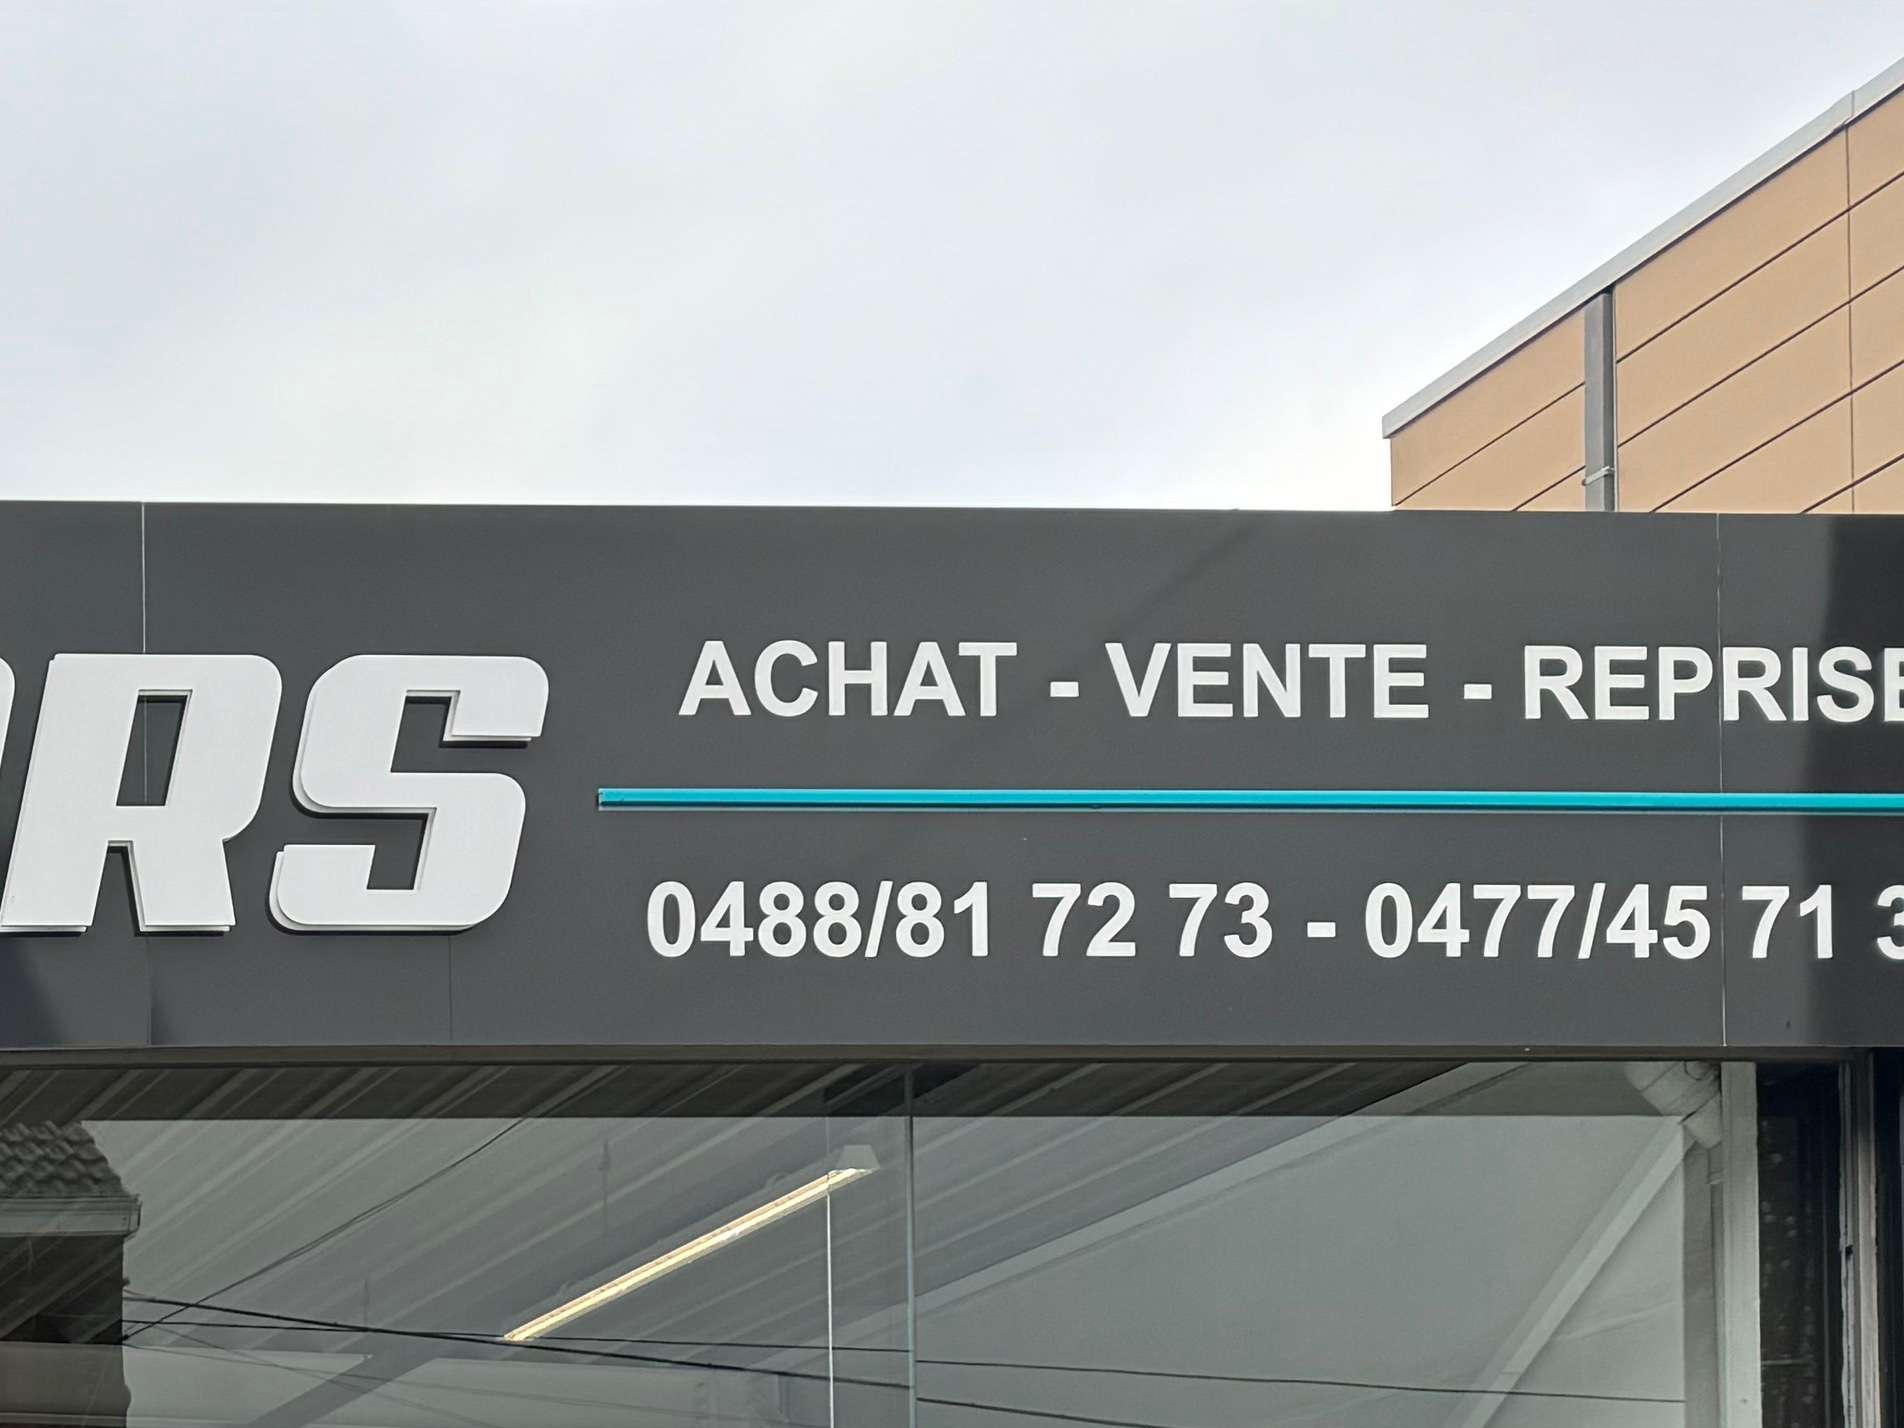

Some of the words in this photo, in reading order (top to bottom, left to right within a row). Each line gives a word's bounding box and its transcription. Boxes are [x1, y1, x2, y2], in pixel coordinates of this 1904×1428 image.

[677, 639, 1018, 718] ACHAT
[1049, 680, 1080, 698] -
[1104, 641, 1430, 719] VENTE
[1463, 683, 1493, 700] -
[646, 879, 990, 958] 0488/81
[1031, 882, 1136, 957] 72
[1168, 881, 1273, 958] 73
[1306, 920, 1337, 938] -
[1364, 881, 1711, 960] 0477/45
[1740, 883, 1834, 960] 71
